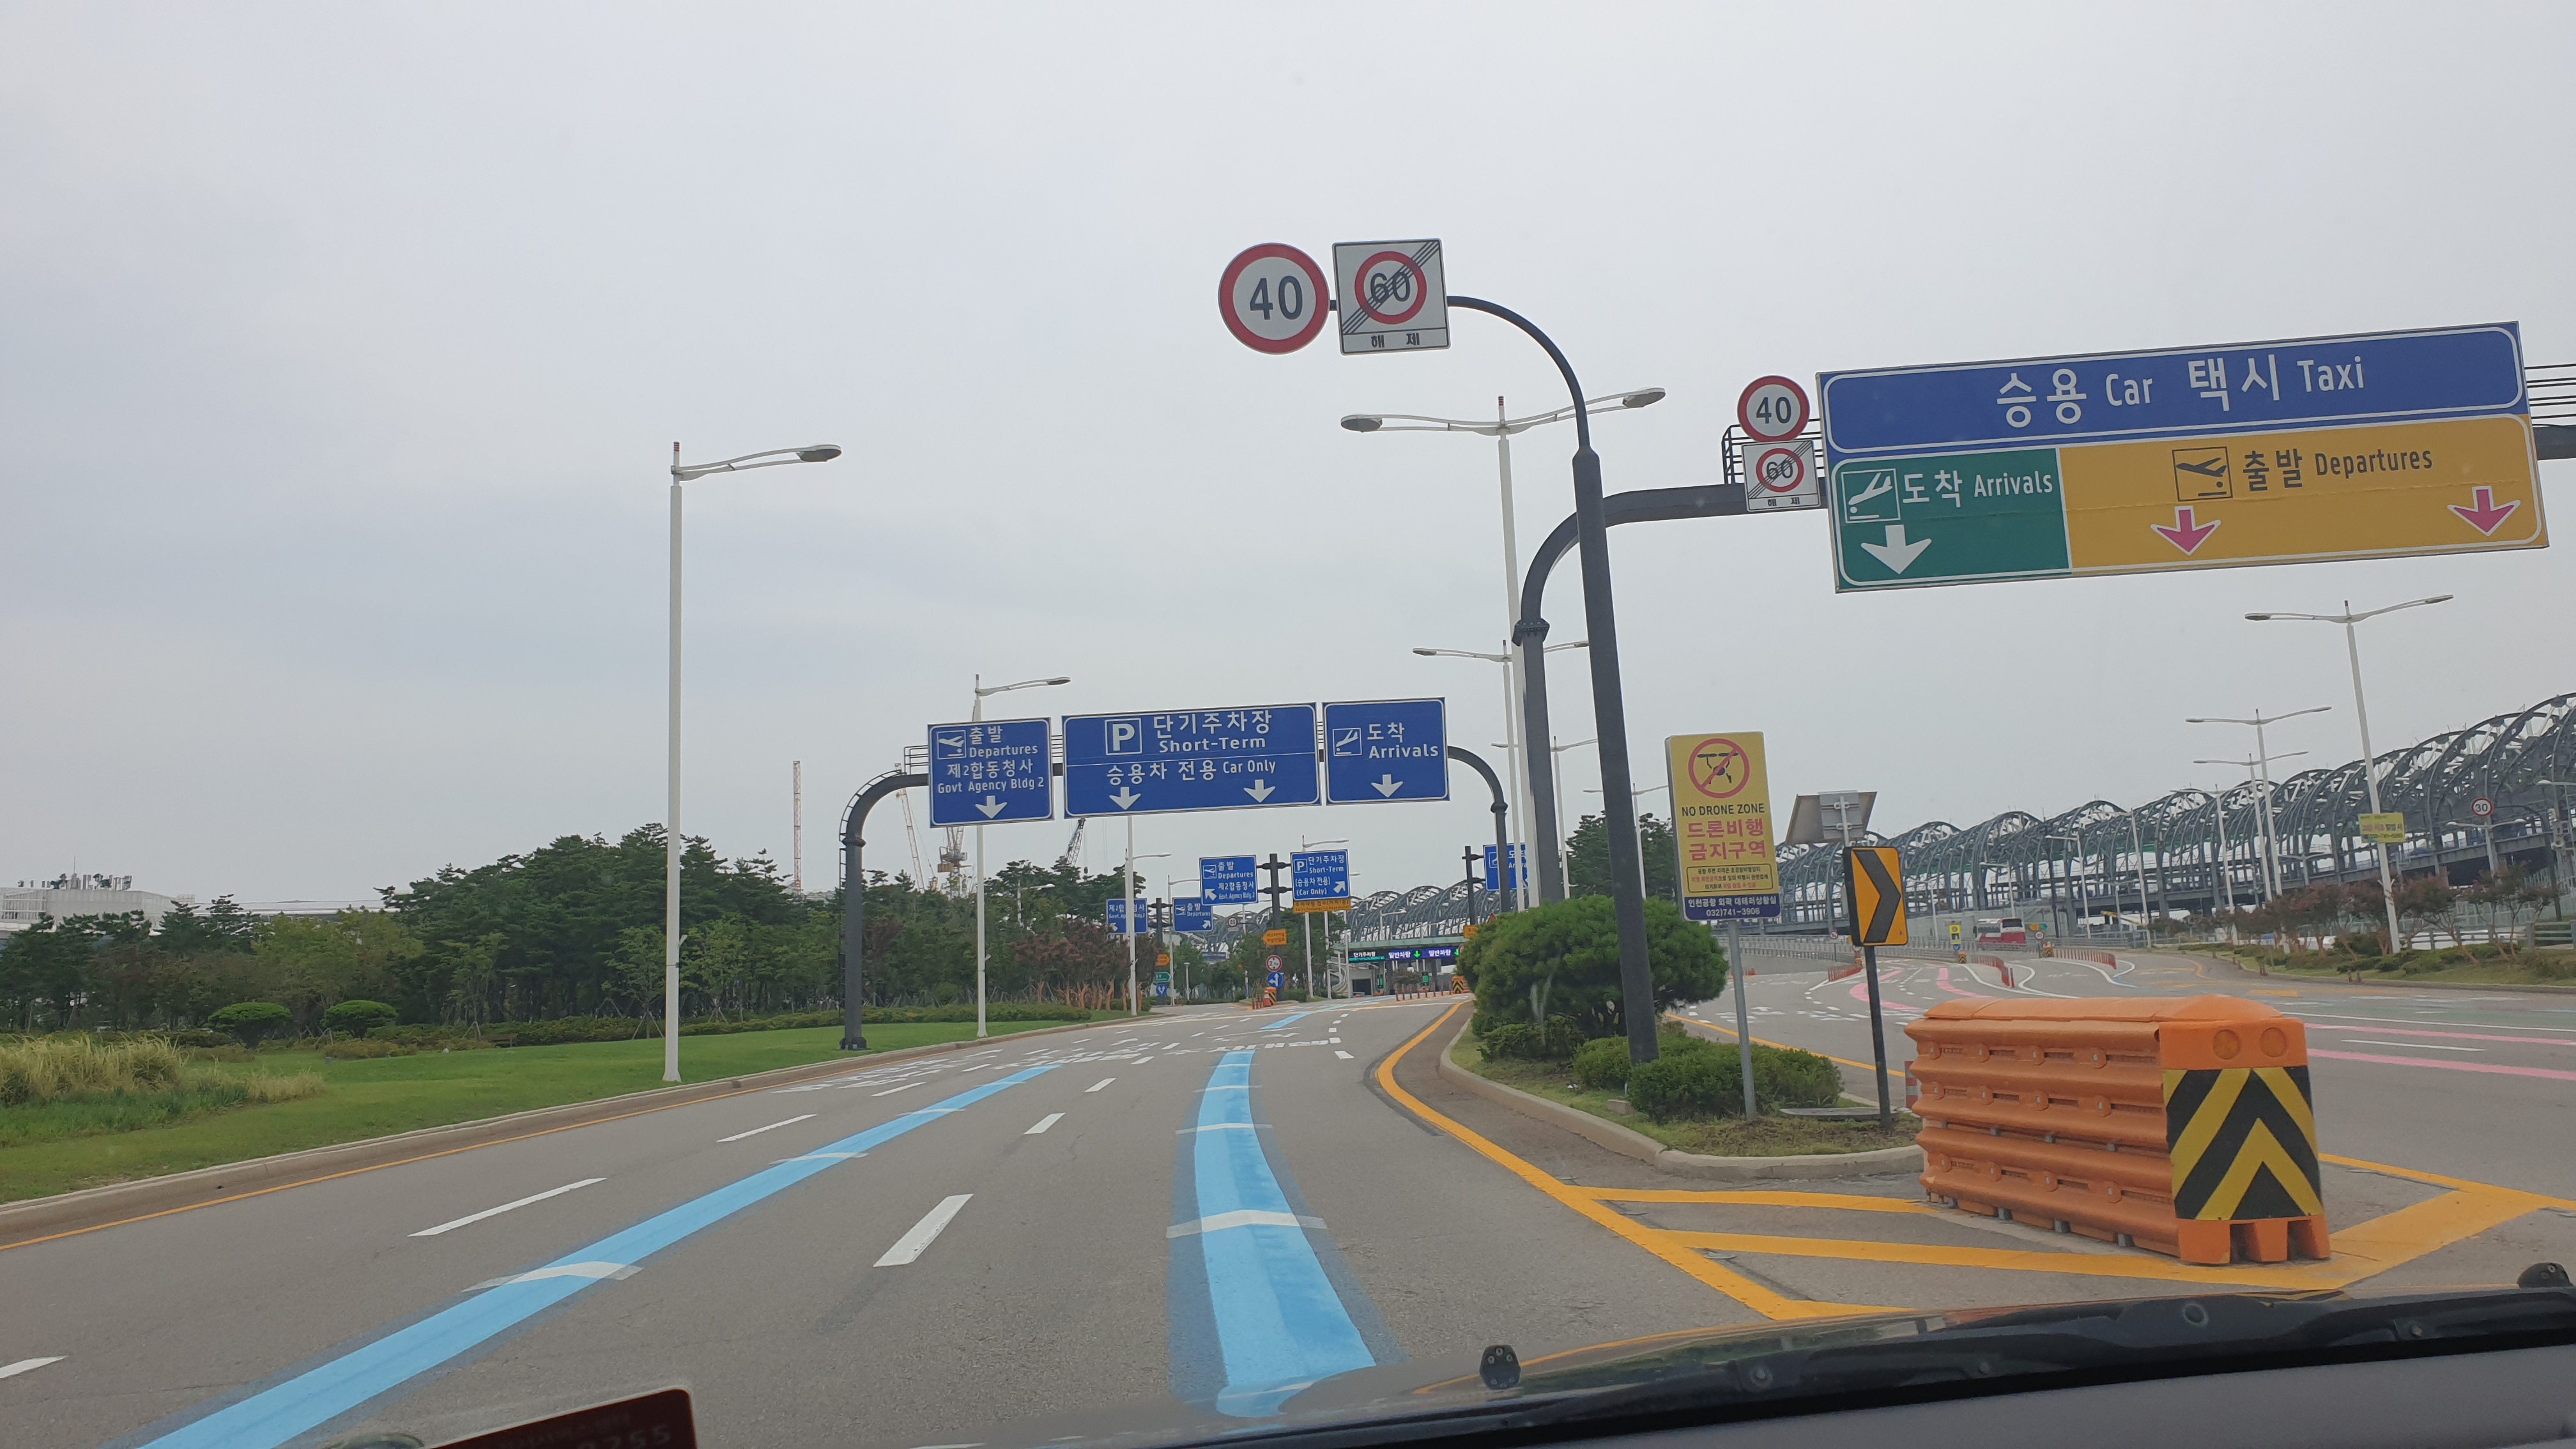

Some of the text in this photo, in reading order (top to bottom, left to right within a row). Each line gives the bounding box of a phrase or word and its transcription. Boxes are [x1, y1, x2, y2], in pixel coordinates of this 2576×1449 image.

[1370, 272, 1411, 303] 60
[1250, 275, 1303, 321] 40
[1997, 354, 2364, 428] 승용 Car 택시 Taxi
[1756, 395, 1792, 425] 40
[1765, 461, 1794, 480] 60
[2243, 448, 2433, 491] 출발 Departures
[1902, 470, 2053, 508] 도착 Arrivals
[1153, 709, 1272, 739] 단기주차장
[1367, 722, 1405, 743] 도착
[969, 725, 1003, 745] 출발
[1159, 737, 1266, 753] Short-Term
[969, 744, 1038, 759] Departures
[1368, 744, 1439, 759] Arrivals
[947, 759, 1033, 779] 제2합동청사
[1107, 759, 1276, 786] 승용차 전용 Car Only
[937, 776, 1045, 793] Govt Agency Bldg 2
[1682, 803, 1765, 816] NO DRONE ZONE
[2475, 804, 2488, 812] 30
[1687, 818, 1765, 839] 드론비행
[1308, 854, 1345, 866] 단기주차장
[1689, 839, 1767, 861] 금지구역
[1218, 861, 1234, 871] 출발
[1309, 866, 1344, 874] Short-Term
[1310, 887, 1327, 896] Only)
[1688, 898, 1717, 907] 인천공항
